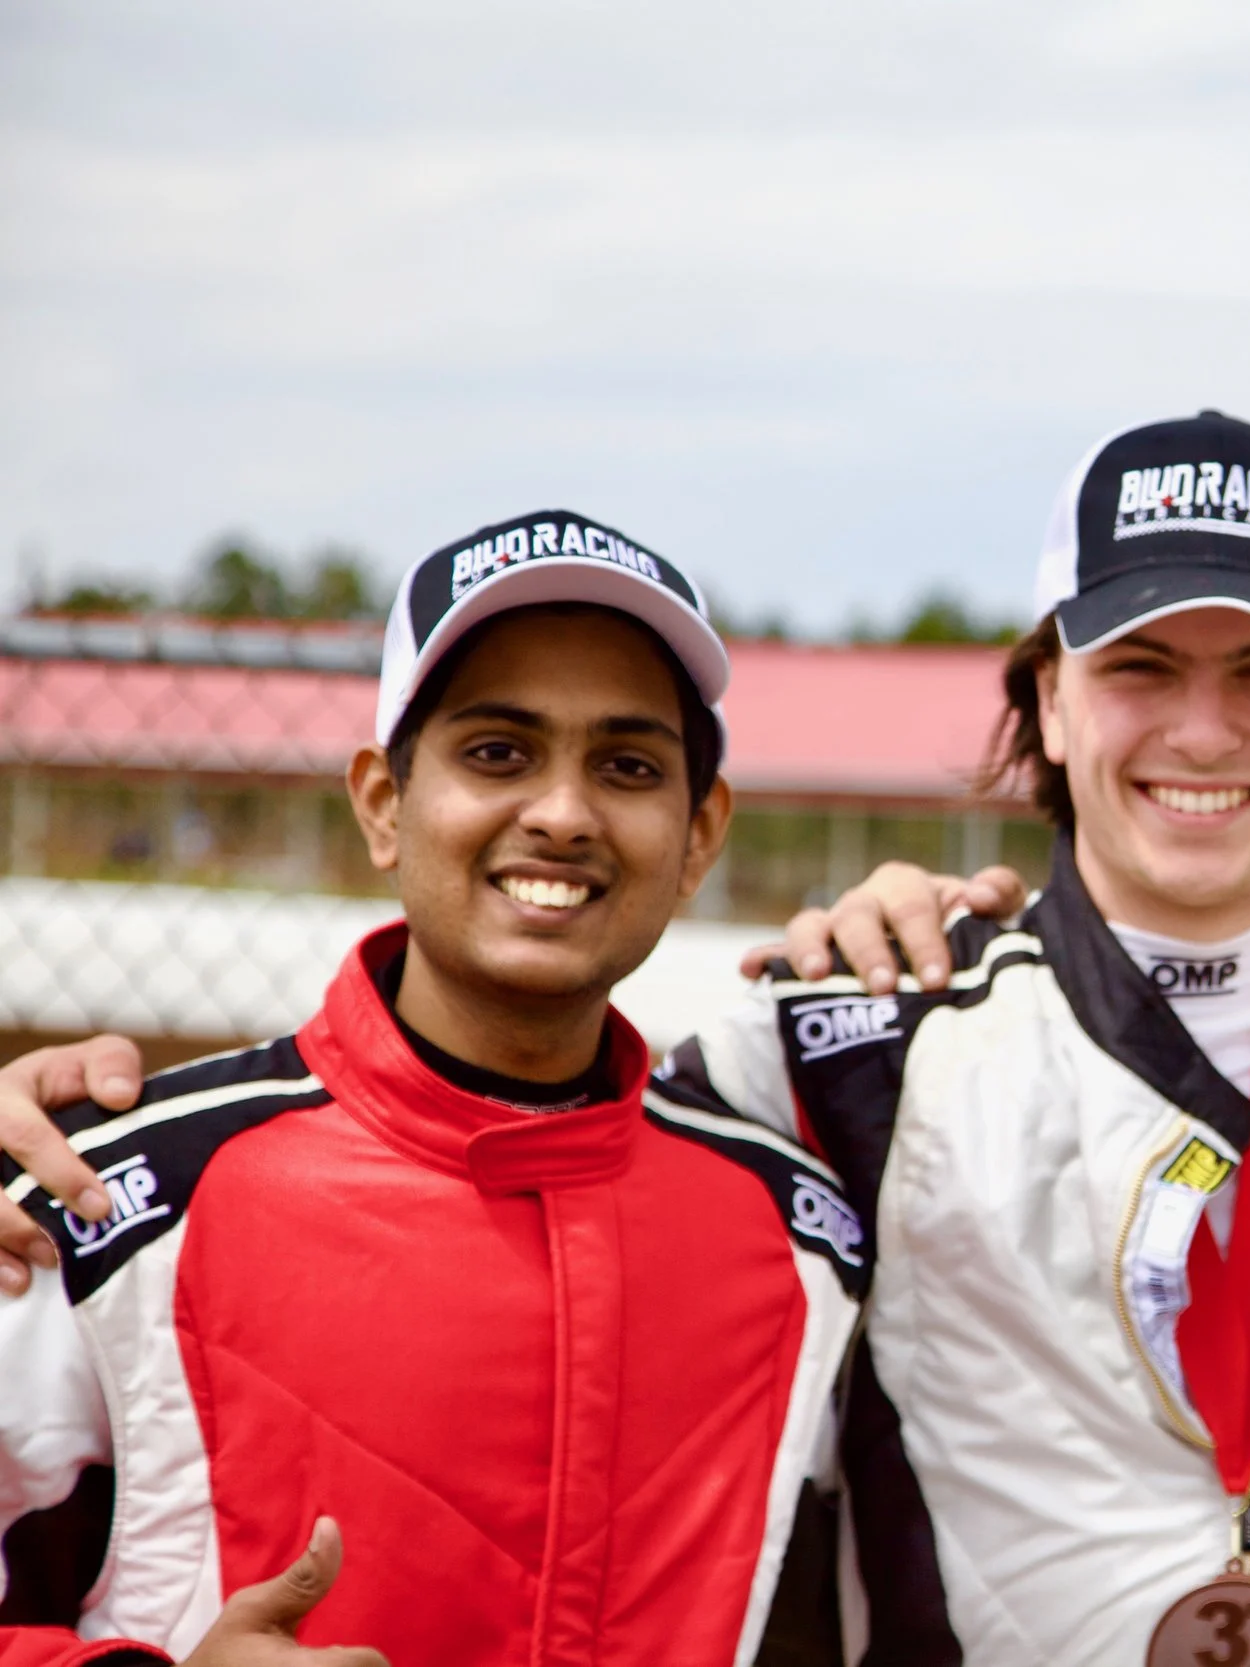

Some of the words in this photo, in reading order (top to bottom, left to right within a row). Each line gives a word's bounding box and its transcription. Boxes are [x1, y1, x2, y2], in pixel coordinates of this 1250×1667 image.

[1151, 962, 1237, 989] OMP
[796, 1003, 899, 1051] OMP
[793, 1186, 864, 1251] OMP
